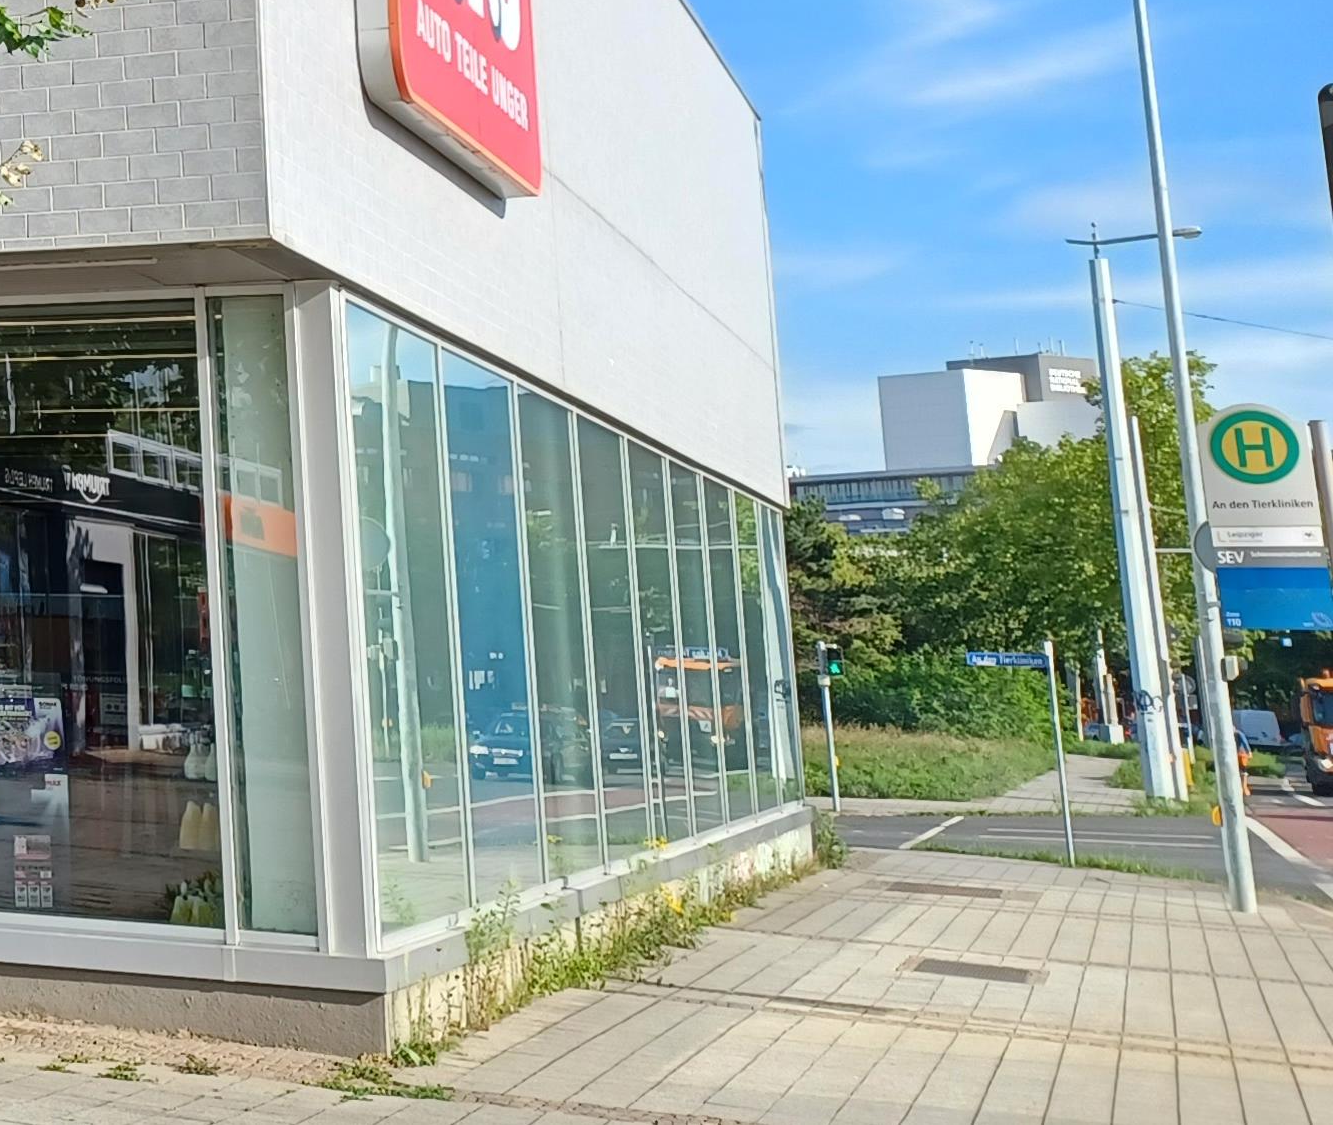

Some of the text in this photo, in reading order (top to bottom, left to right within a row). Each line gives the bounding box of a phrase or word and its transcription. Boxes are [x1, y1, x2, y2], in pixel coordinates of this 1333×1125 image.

[454, 31, 488, 97] TEILE
[491, 65, 529, 132] UNGER
[1212, 499, 1314, 509] An den Tierkliniken
[1217, 550, 1245, 564] SEV
